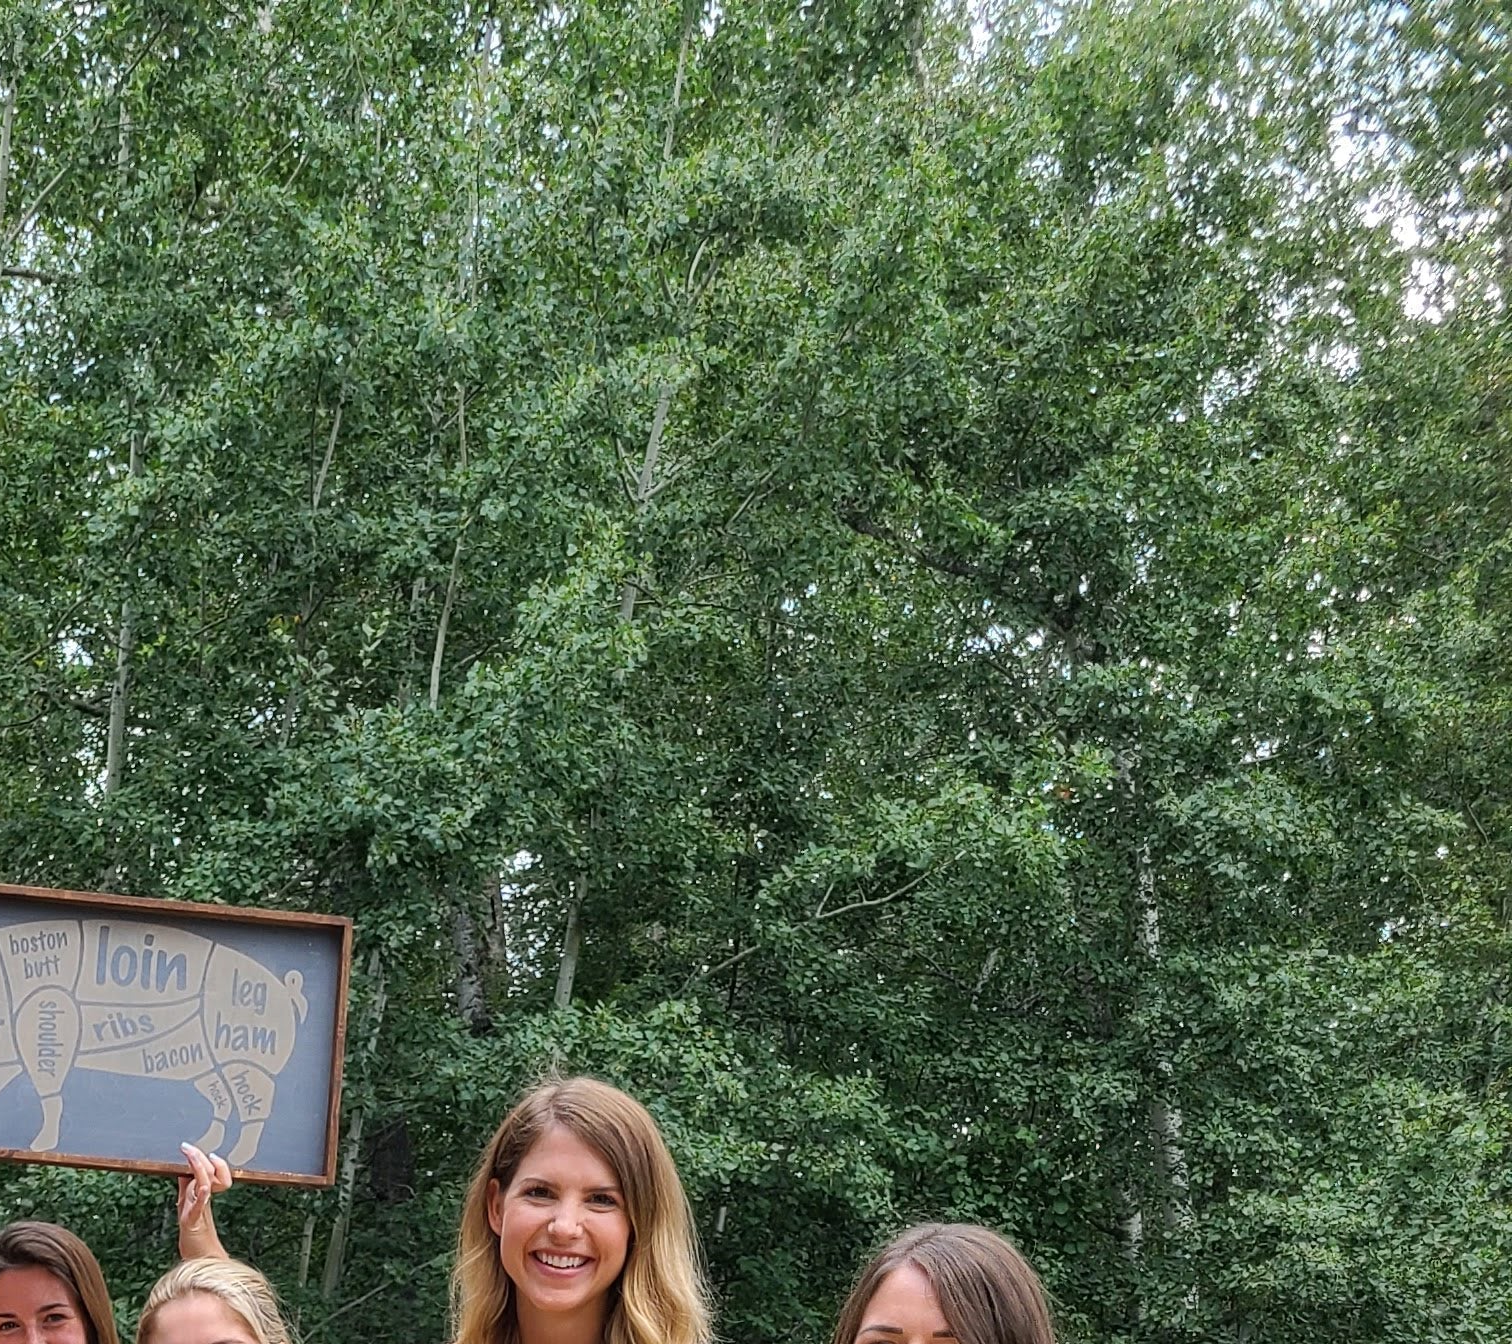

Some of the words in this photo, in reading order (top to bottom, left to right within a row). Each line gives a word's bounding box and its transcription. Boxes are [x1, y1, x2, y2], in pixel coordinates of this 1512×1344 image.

[8, 929, 69, 955] boston
[95, 924, 187, 993] loin
[24, 954, 61, 979] butt
[231, 967, 268, 1016] leg
[37, 999, 58, 1086] shoulder
[93, 1008, 155, 1040] ribs
[214, 1011, 277, 1056] ham
[142, 1040, 204, 1074] bacon
[208, 1080, 227, 1110] hock
[231, 1070, 262, 1117] hock
